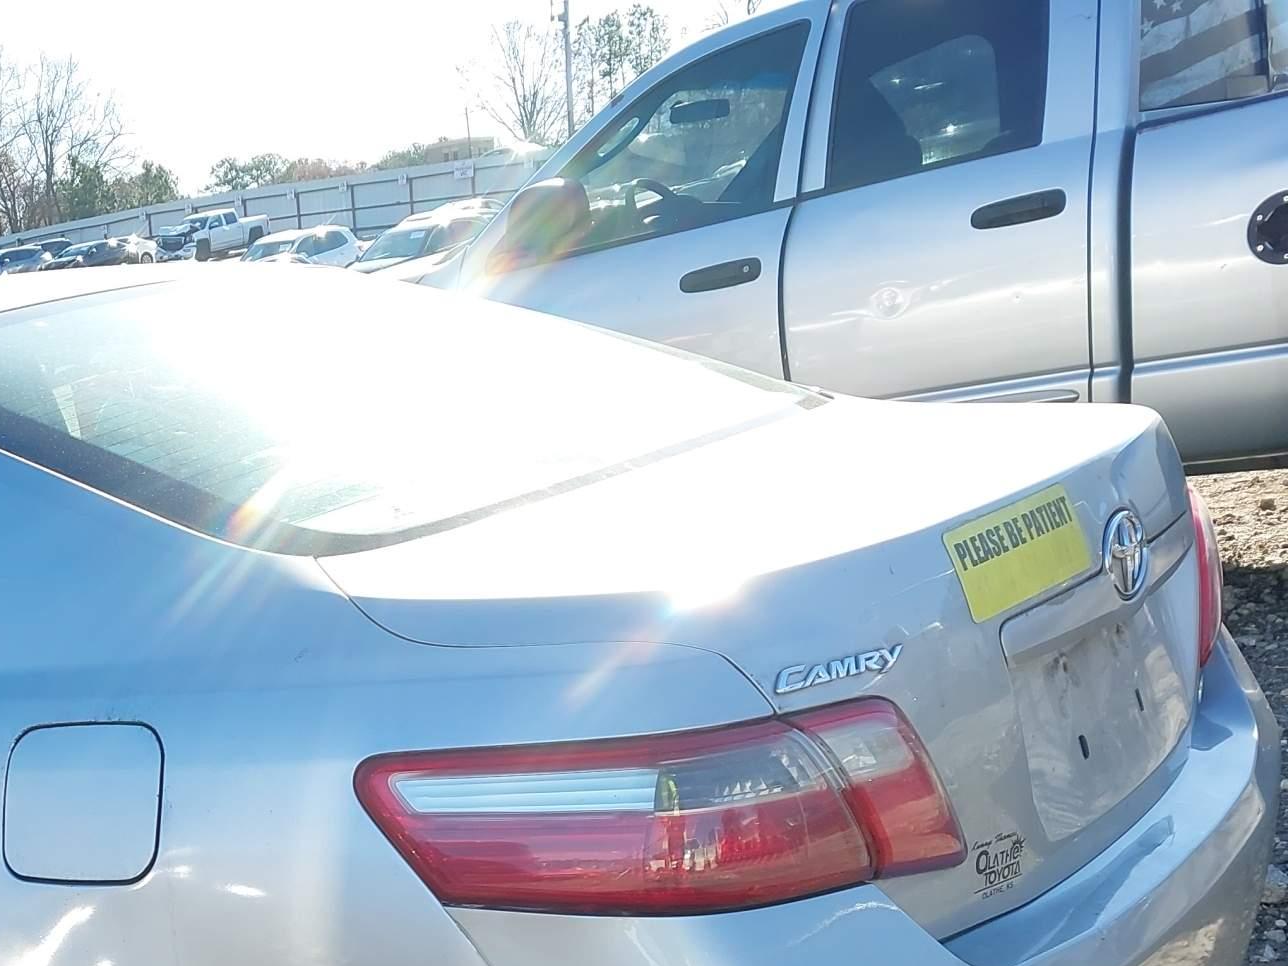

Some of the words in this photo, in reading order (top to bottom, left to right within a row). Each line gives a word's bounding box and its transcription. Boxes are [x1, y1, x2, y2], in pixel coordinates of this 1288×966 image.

[954, 525, 1010, 571] PLEASE
[1004, 518, 1027, 549] BE
[1021, 496, 1073, 540] PATIENT
[775, 643, 904, 694] CAMRY
[984, 860, 1021, 887] TOYOTA
